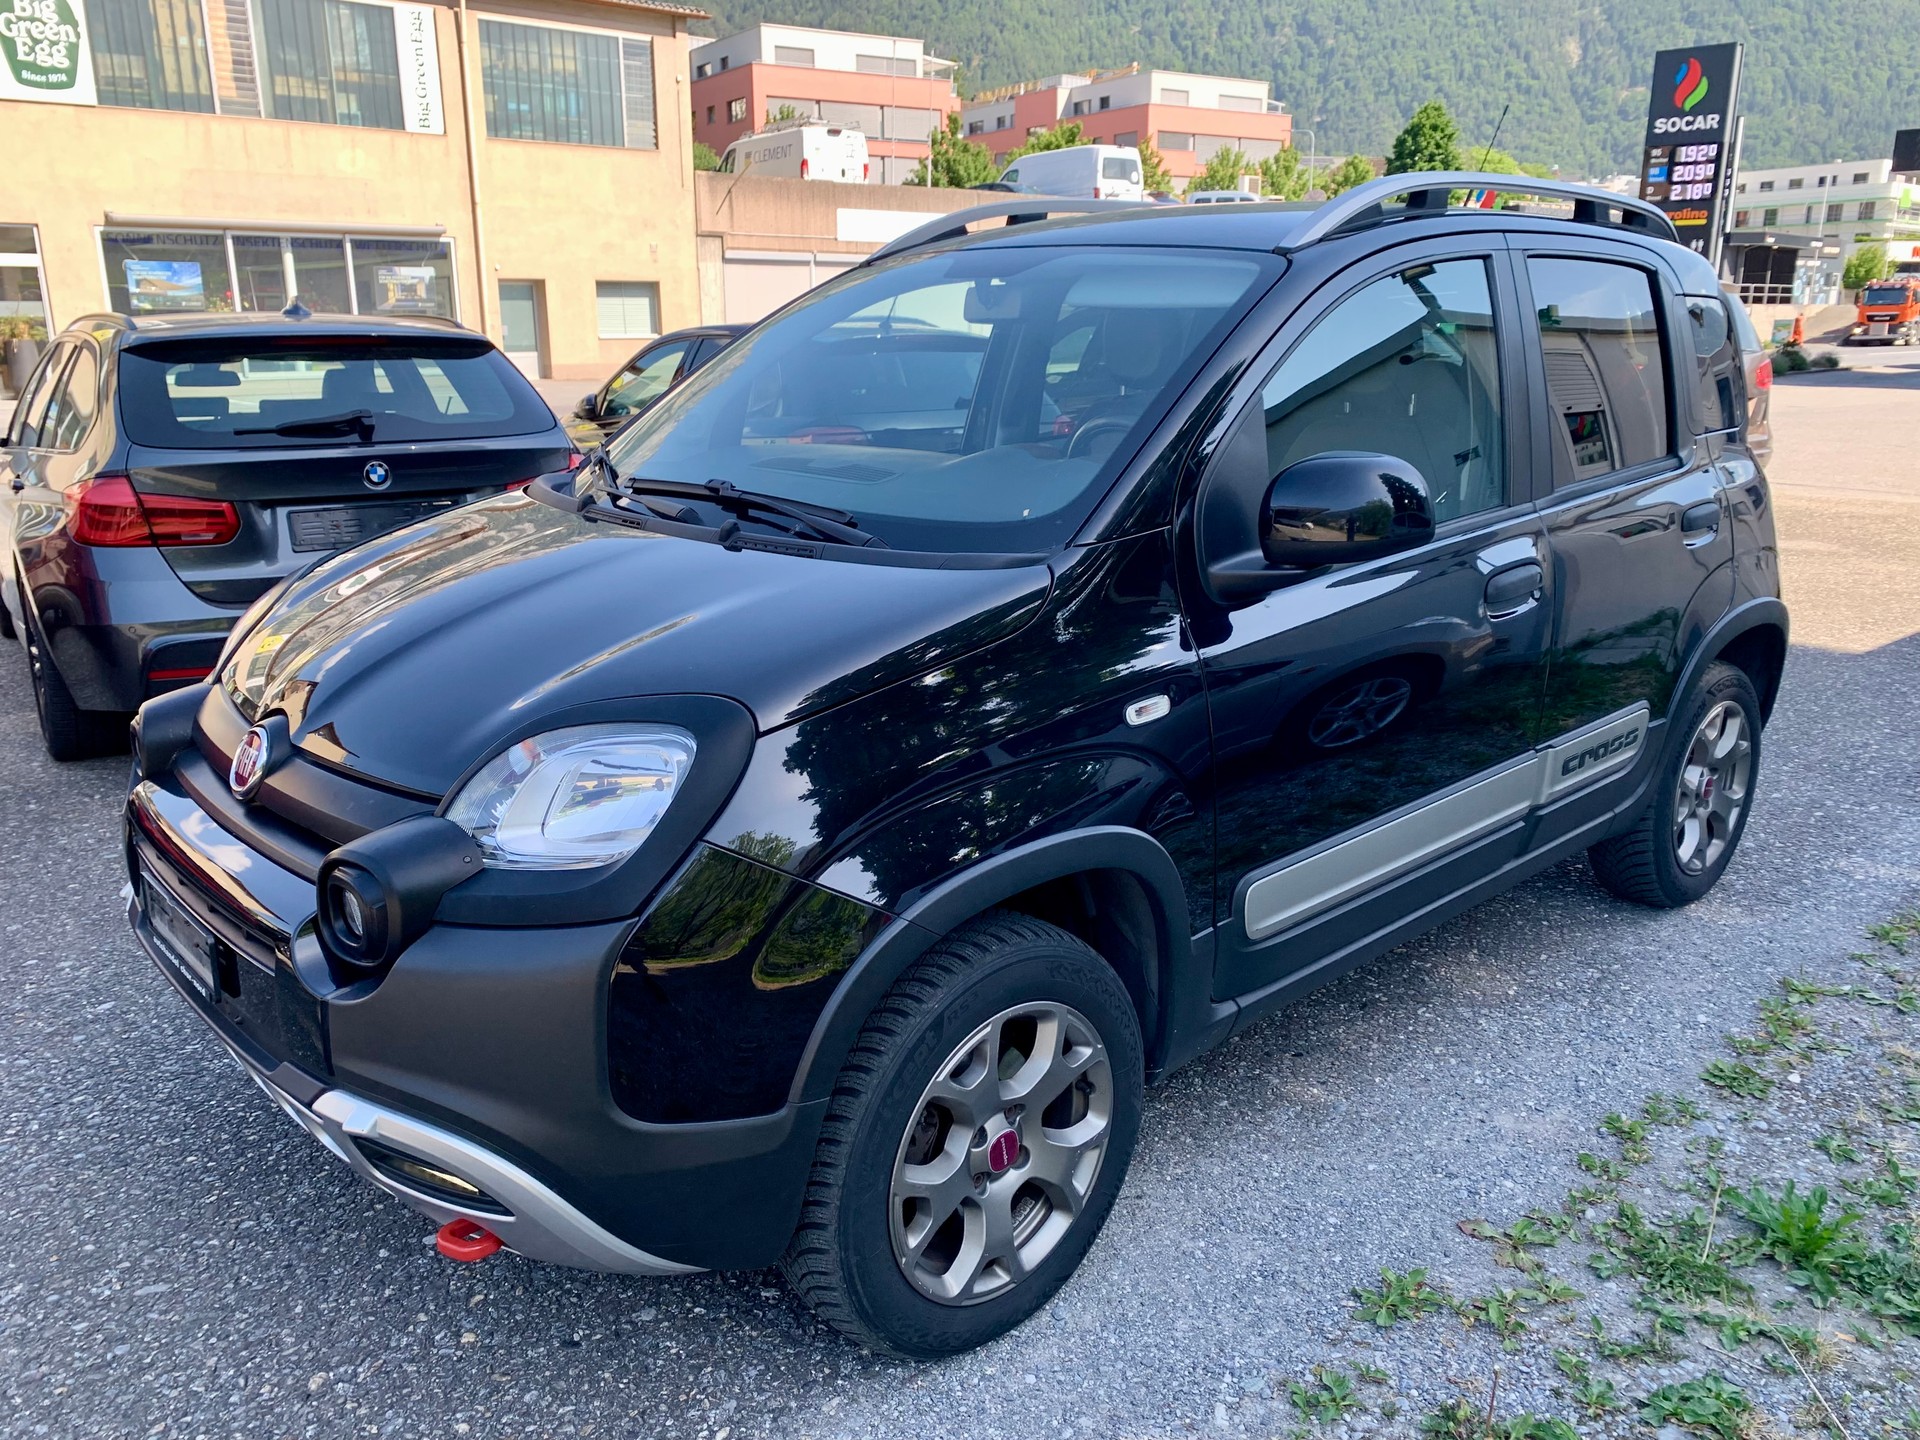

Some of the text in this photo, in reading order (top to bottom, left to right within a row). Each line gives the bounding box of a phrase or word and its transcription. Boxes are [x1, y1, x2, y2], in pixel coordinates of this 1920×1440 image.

[13, 0, 59, 23] Big
[0, 12, 77, 43] Green
[14, 37, 70, 68] Egg
[21, 69, 68, 83] Since 1974
[409, 11, 431, 128] Big Green Egg
[1653, 114, 1720, 134] SOCAR
[753, 144, 793, 164] CLEMENT
[237, 744, 259, 778] FIAT
[1000, 1137, 1009, 1166] panda
